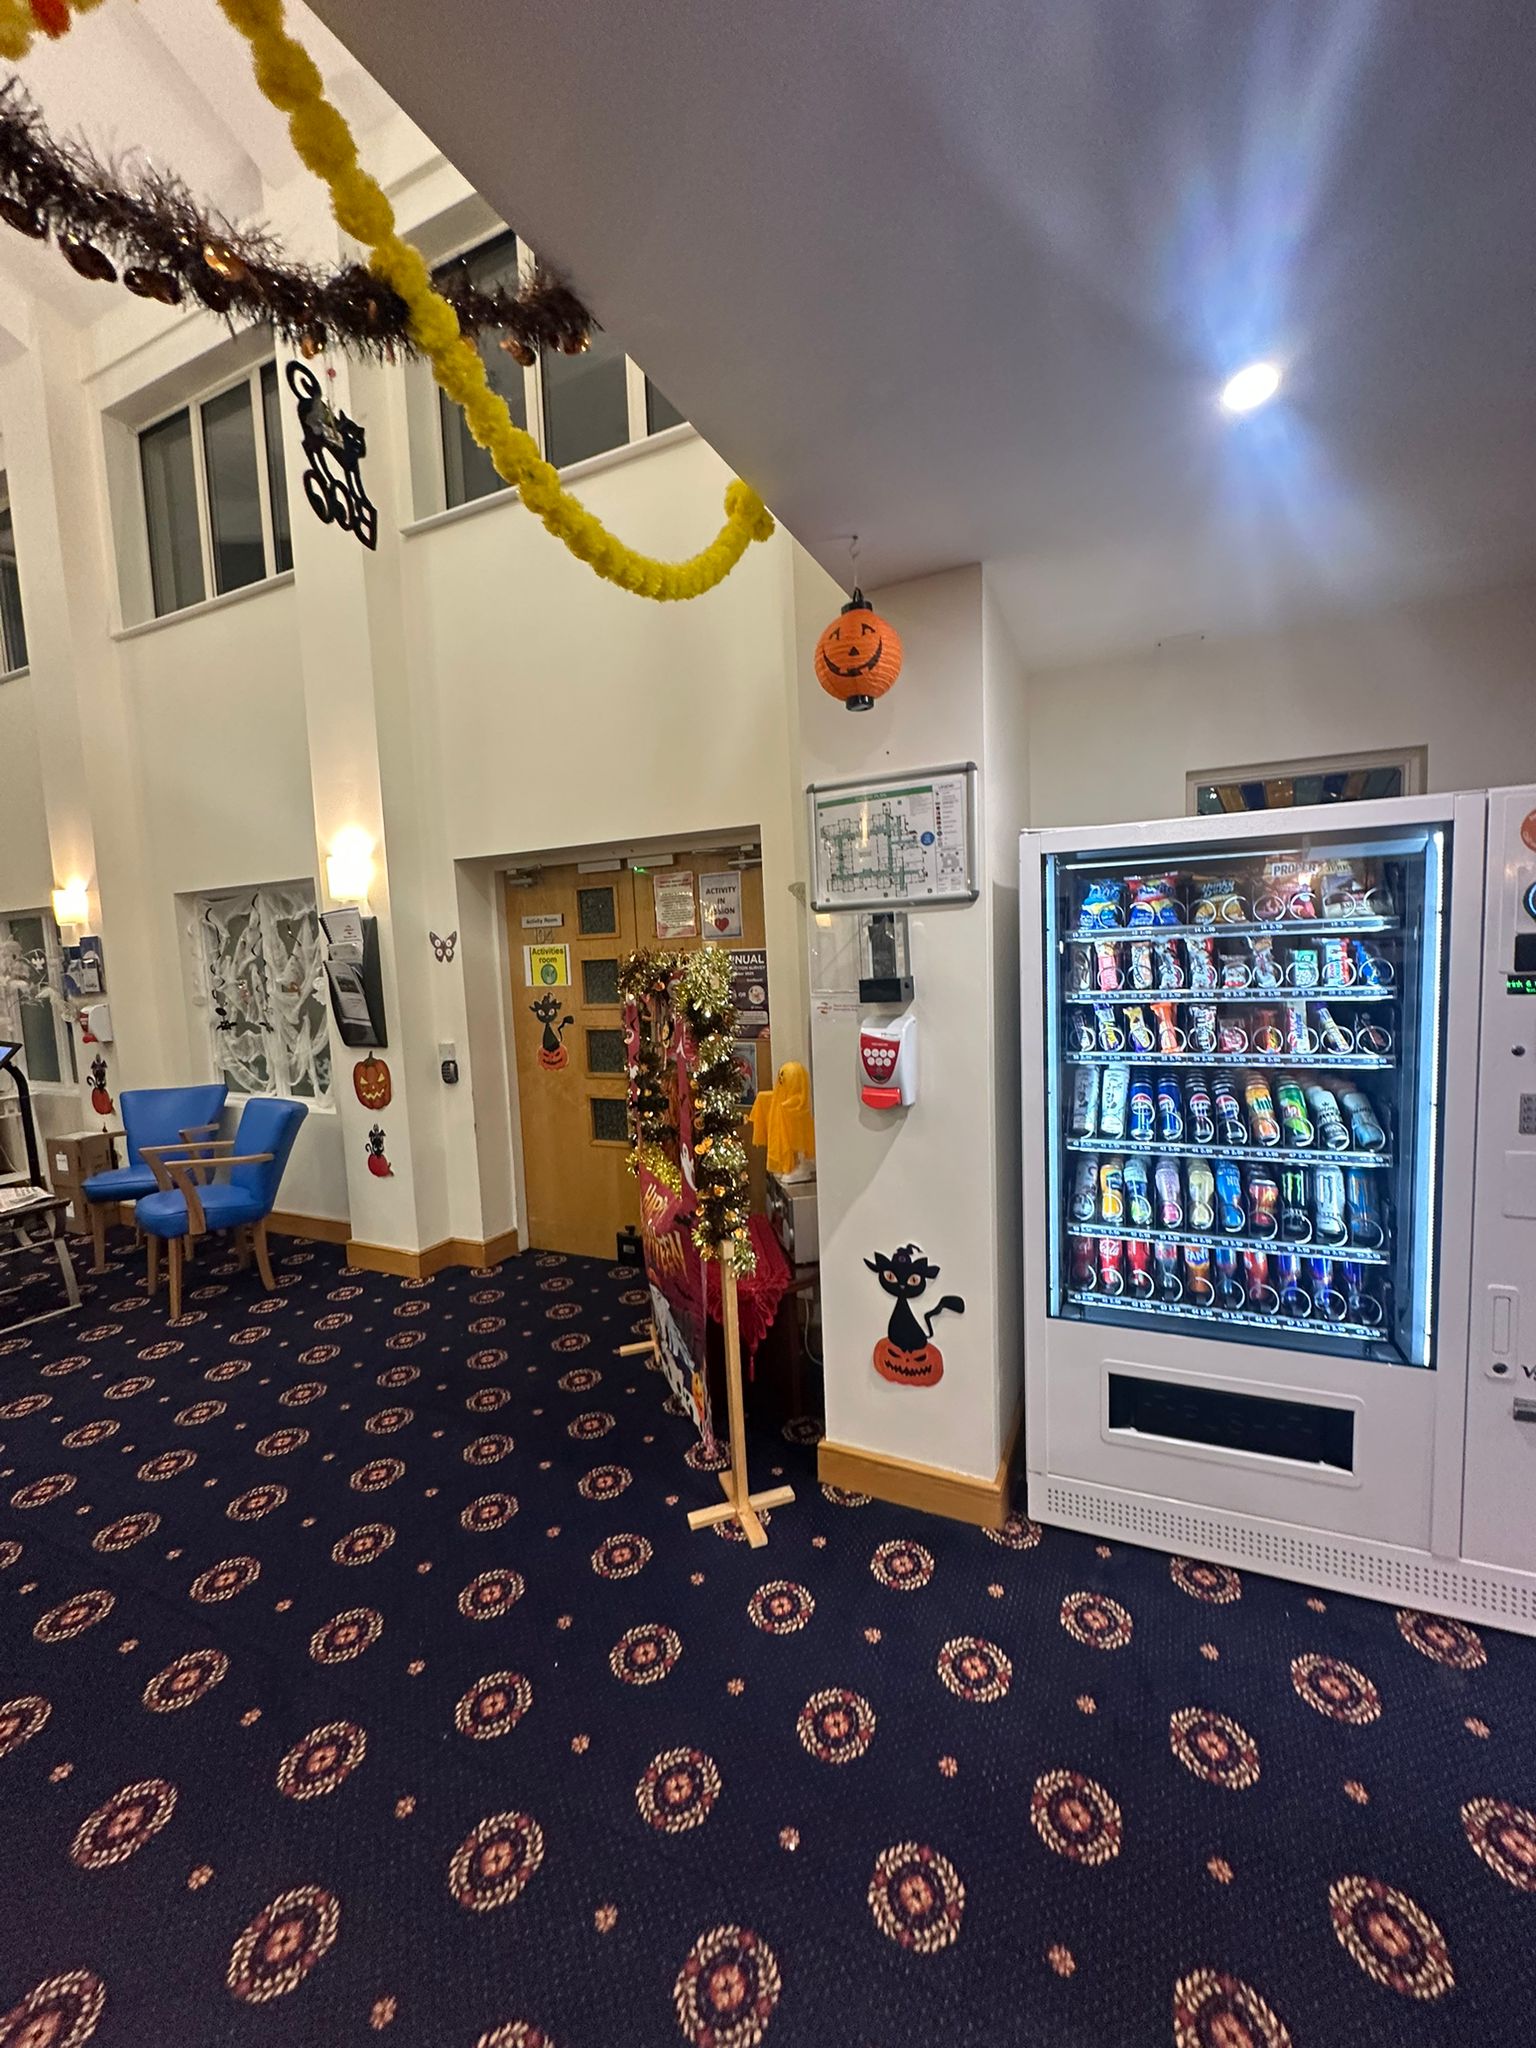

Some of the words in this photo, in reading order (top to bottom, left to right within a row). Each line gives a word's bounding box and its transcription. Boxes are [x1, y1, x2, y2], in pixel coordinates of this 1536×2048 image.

[705, 886, 737, 895] ACTIVITY
[717, 897, 726, 905] IN
[532, 947, 564, 956] Activities
[731, 954, 765, 964] NUAL
